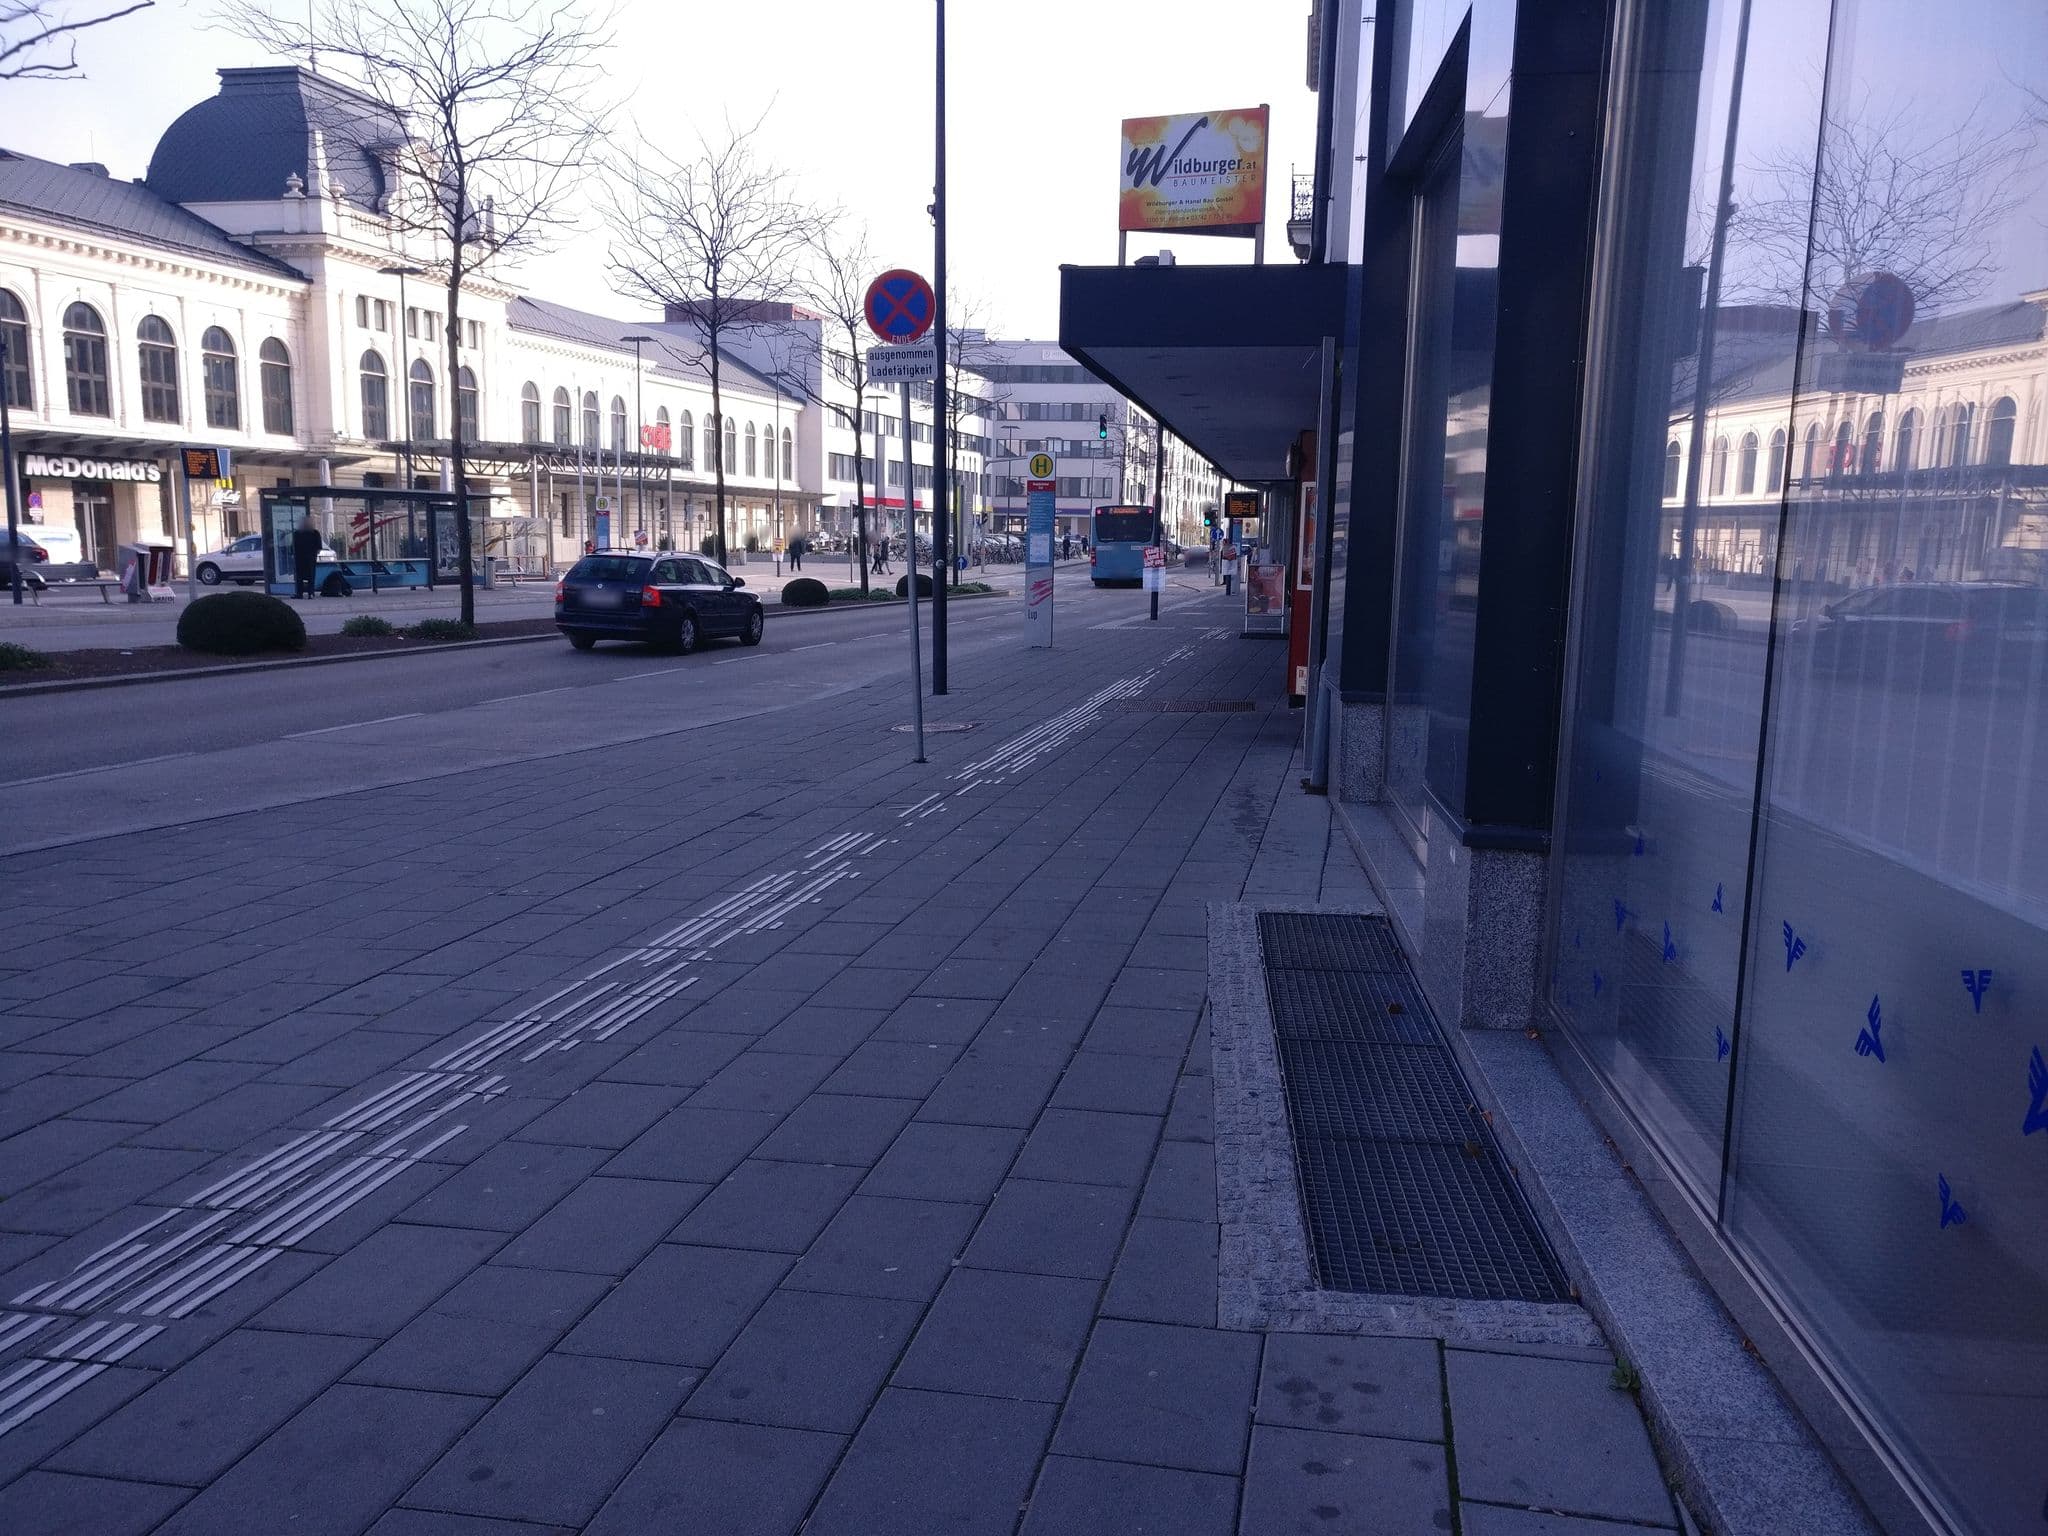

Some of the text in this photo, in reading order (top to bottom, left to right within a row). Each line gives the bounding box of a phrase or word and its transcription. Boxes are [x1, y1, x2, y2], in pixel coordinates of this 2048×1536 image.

[1173, 175, 1257, 187] BAUMEISTER
[891, 335, 911, 345] ENDE
[869, 350, 934, 362] ausgenommen
[871, 364, 932, 377] Ladetätigkeit
[25, 454, 161, 482] McDonald's
